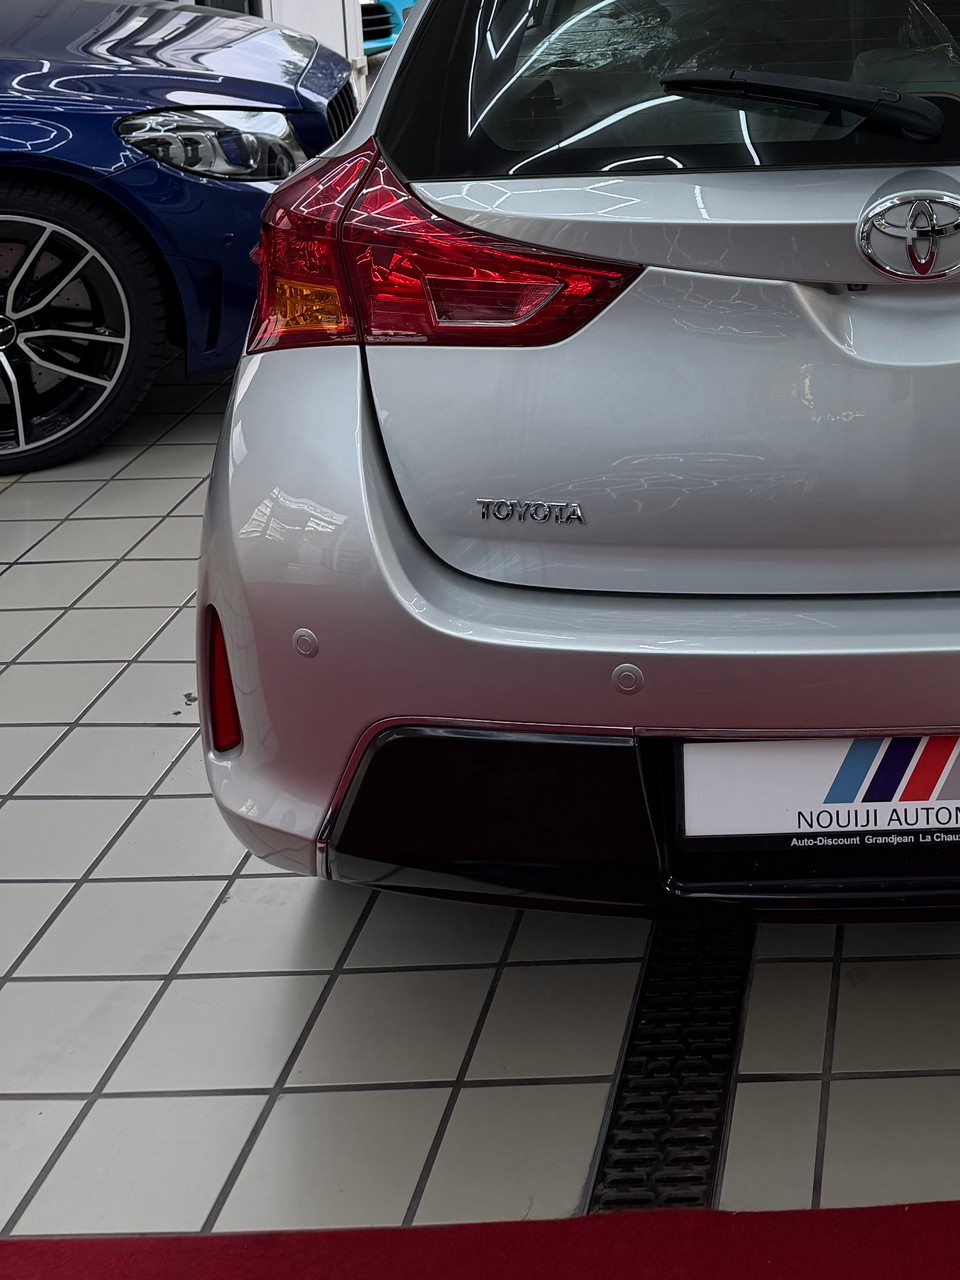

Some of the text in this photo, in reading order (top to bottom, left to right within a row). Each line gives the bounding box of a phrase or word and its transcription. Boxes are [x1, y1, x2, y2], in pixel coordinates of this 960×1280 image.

[476, 498, 586, 526] TOYOTA
[797, 808, 878, 829] NOUIJI
[791, 836, 860, 847] Auto-Discount
[864, 834, 914, 846] Grandjean
[919, 833, 931, 842] La
